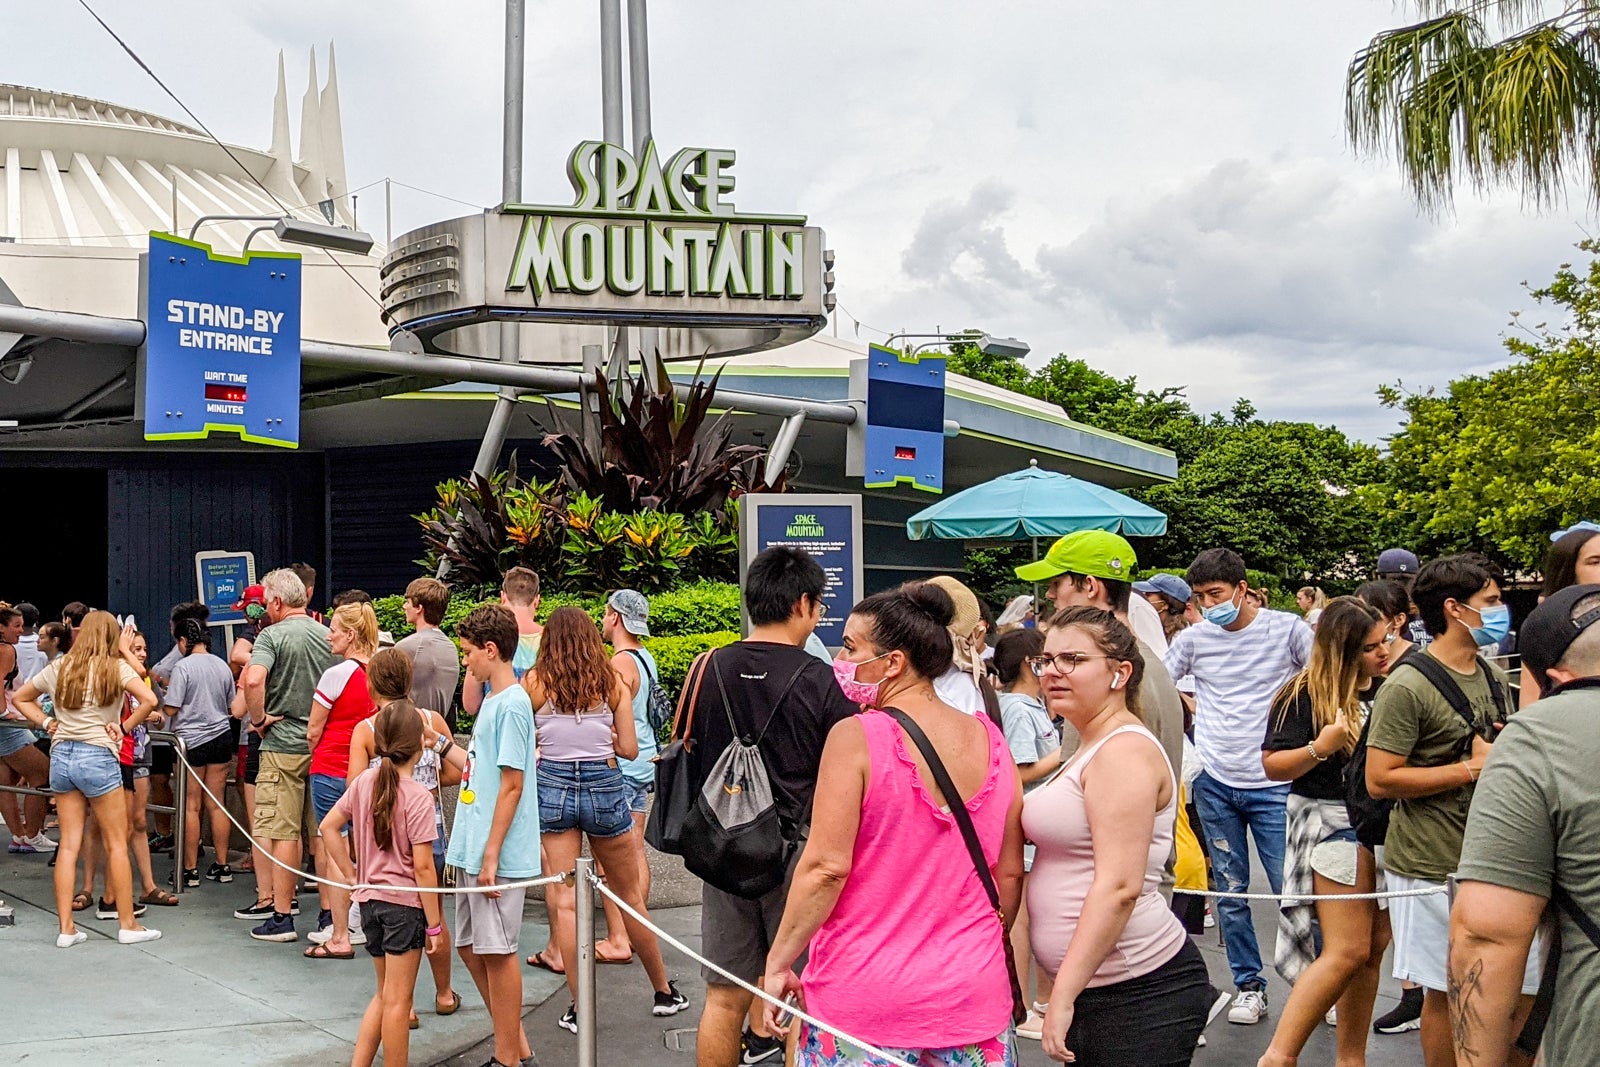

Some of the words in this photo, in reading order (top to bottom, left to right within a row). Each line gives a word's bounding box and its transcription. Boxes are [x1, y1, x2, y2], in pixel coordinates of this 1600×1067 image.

[567, 138, 736, 217] SPACE
[505, 215, 805, 304] MOUNTAIN
[167, 299, 285, 334] STAND-BY
[179, 328, 273, 355] ENTRANCE
[204, 371, 226, 381] WAIT
[228, 373, 248, 383] TIME
[206, 404, 244, 415] MINUTES
[795, 514, 816, 524] SPACE
[785, 525, 824, 537] MOUNTAIN
[217, 584, 234, 594] play
